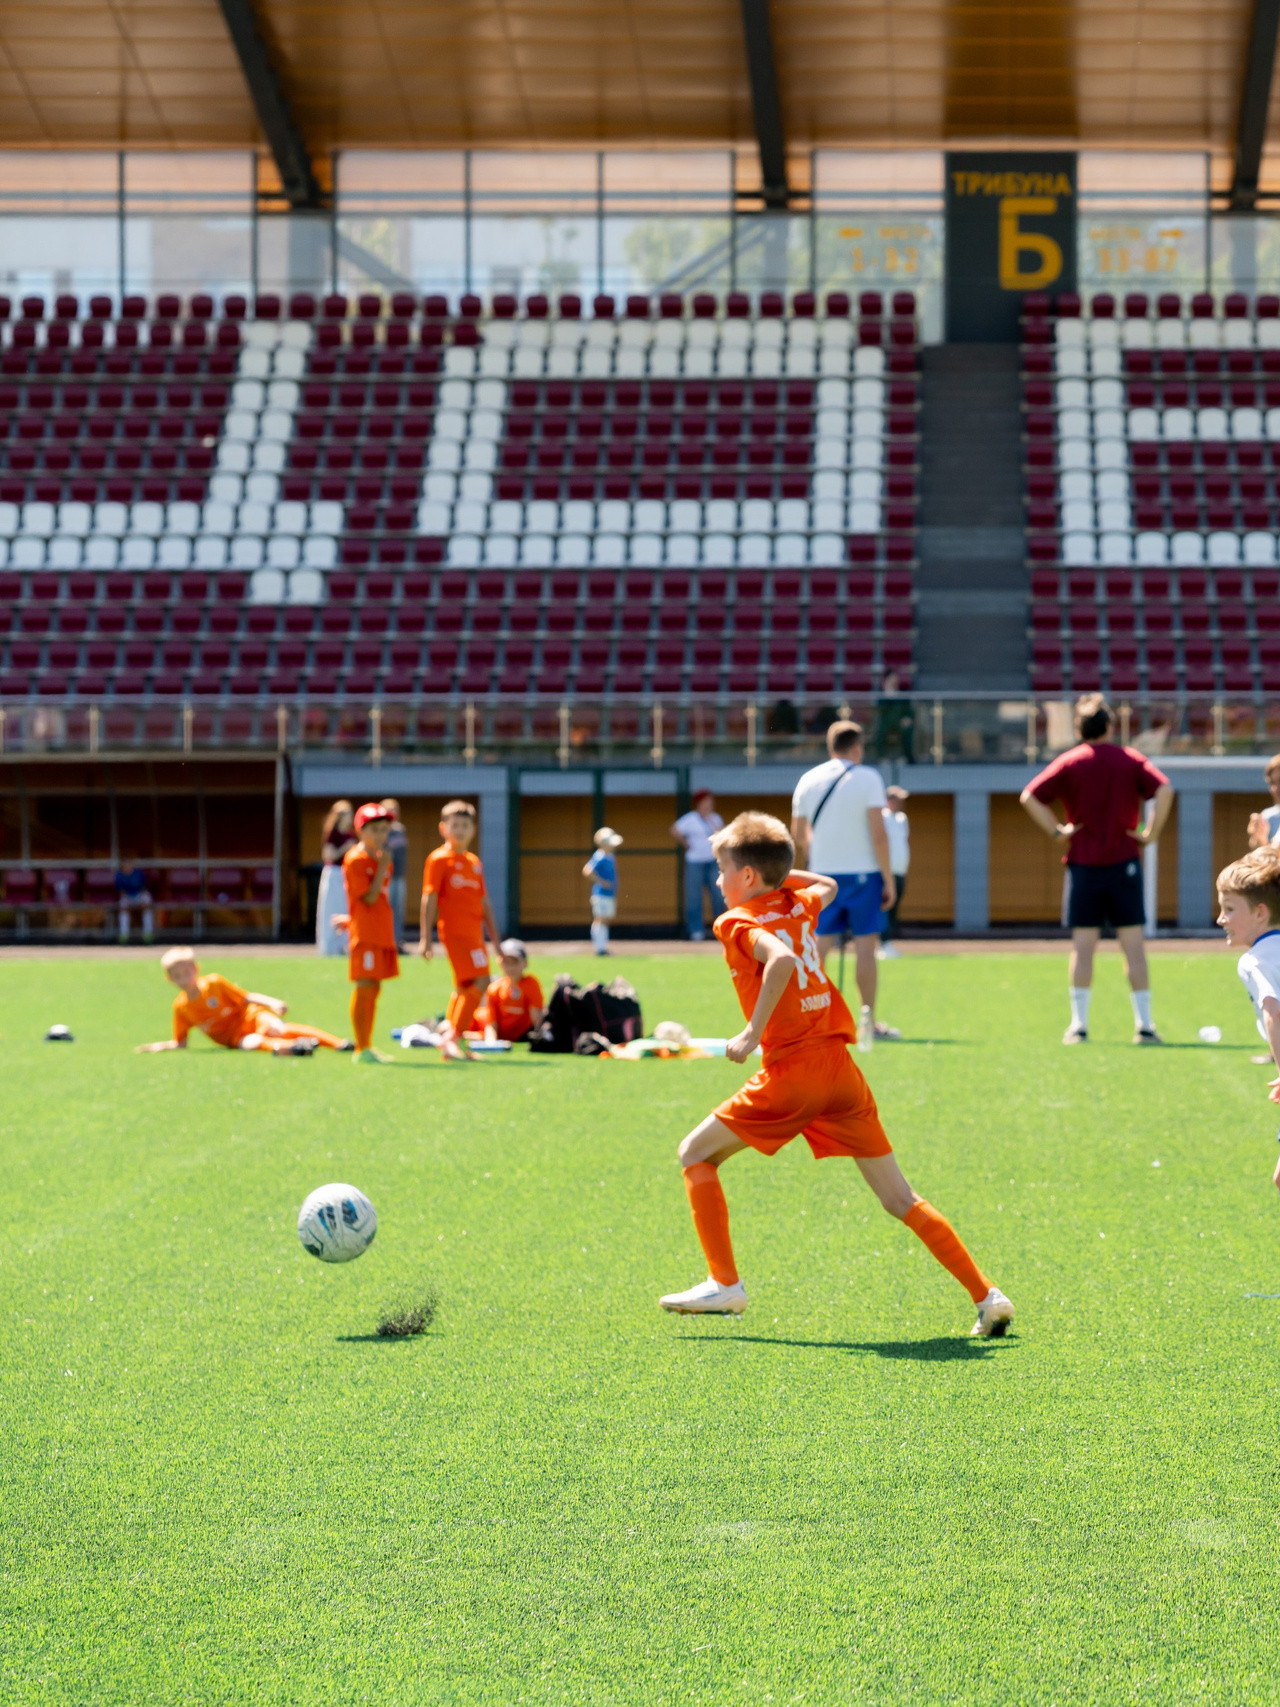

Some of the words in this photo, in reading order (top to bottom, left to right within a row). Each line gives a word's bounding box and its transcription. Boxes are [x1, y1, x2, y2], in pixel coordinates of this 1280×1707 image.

[952, 171, 1072, 197] ТРИБУНА
[999, 197, 1063, 290] Б
[775, 921, 827, 990] 14
